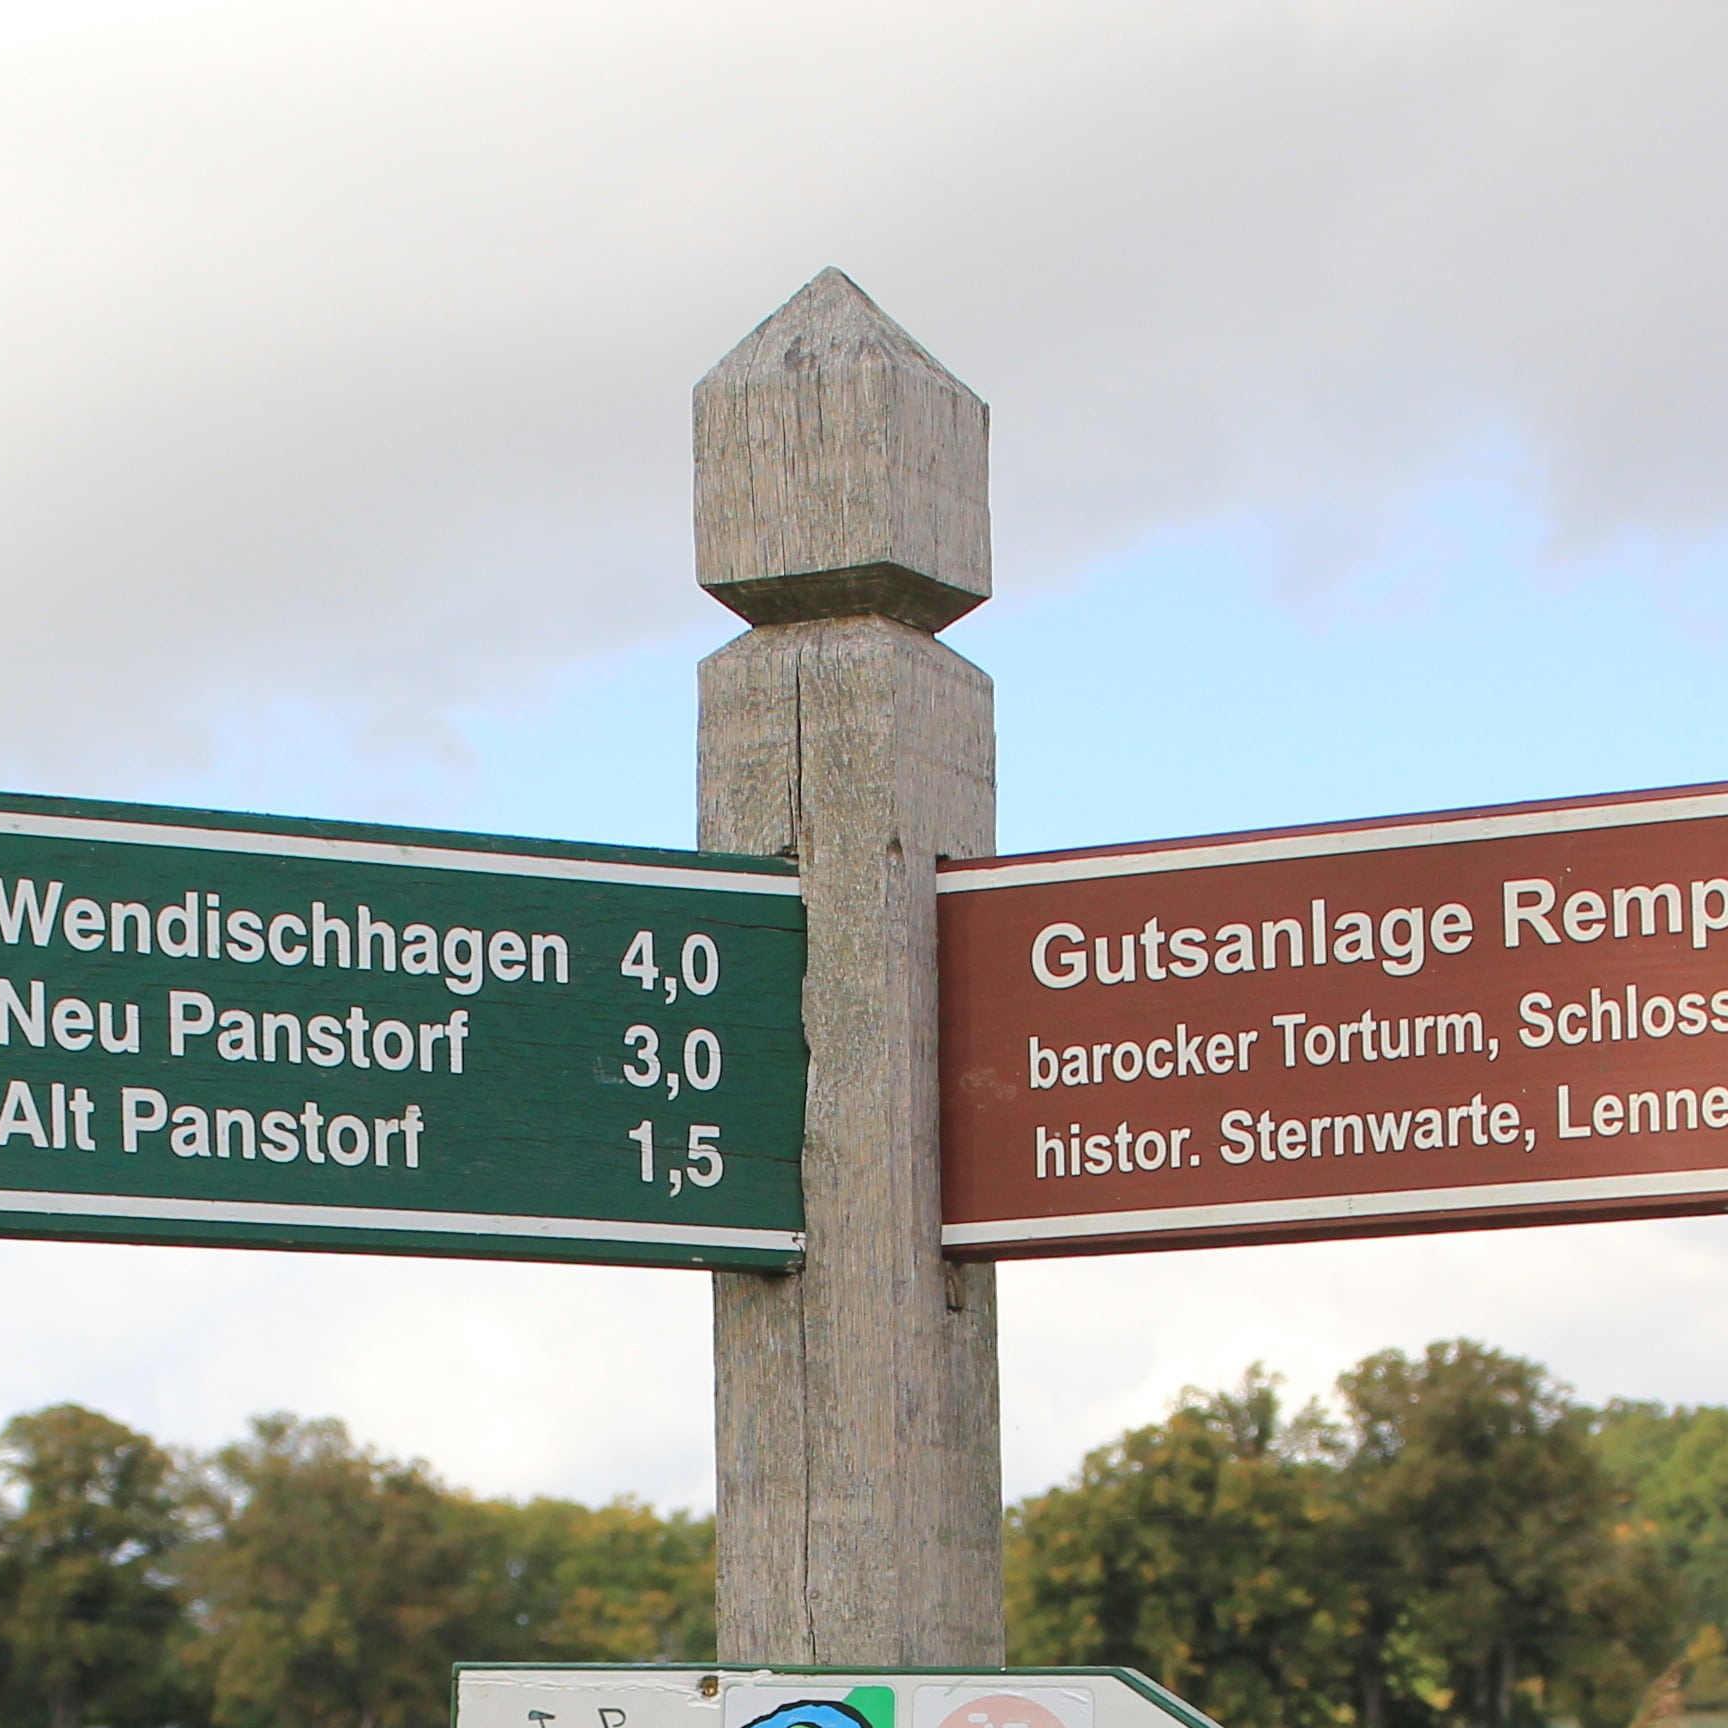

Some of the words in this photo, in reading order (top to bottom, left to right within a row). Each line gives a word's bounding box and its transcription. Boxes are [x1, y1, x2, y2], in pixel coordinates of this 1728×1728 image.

[620, 930, 720, 1005] 4,0
[1030, 898, 1473, 990] Gutsanlage
[169, 990, 469, 1074] Panstorf
[623, 1025, 723, 1100] 3,0
[1029, 1025, 1257, 1090] barocker
[1273, 1009, 1499, 1068] Torturm,
[122, 1086, 425, 1169] Panstorf
[628, 1120, 724, 1197] 1,5
[1034, 1126, 1200, 1179] histor.
[1219, 1093, 1535, 1165] Sternwarte,
